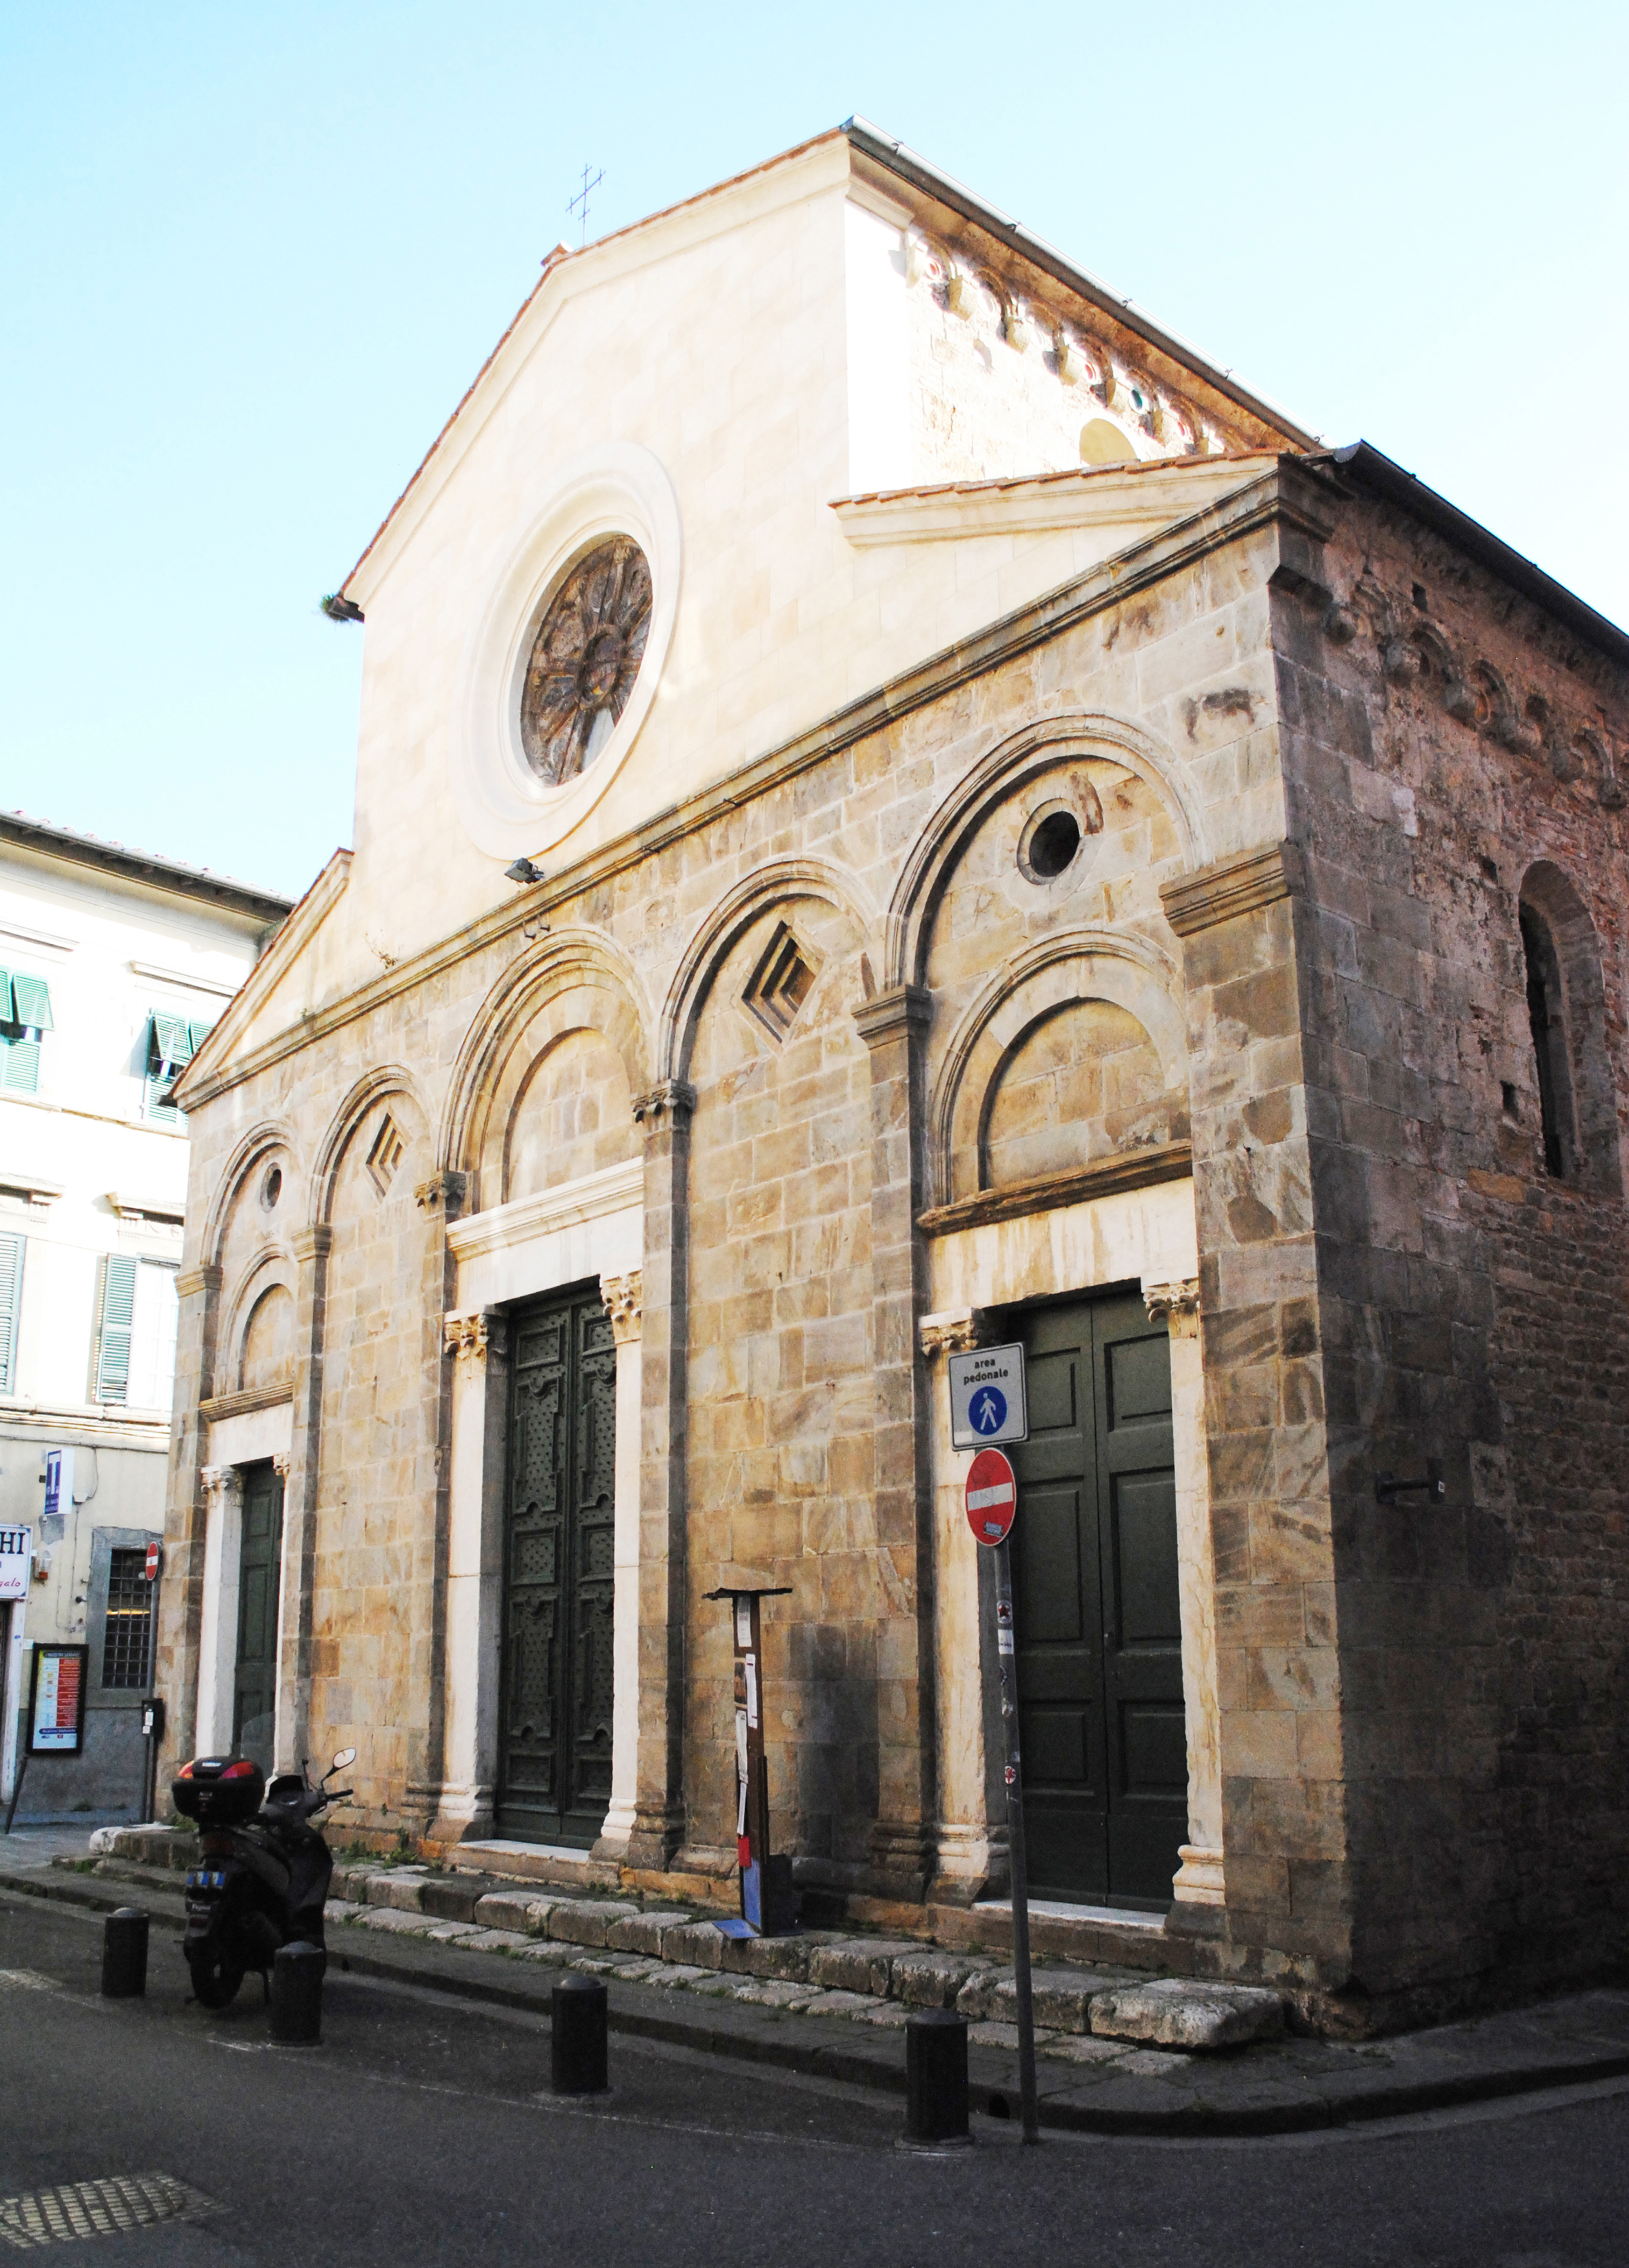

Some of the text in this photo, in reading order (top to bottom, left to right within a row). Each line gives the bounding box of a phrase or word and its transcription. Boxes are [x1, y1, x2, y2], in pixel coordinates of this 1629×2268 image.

[975, 1358, 995, 1369] area
[963, 1368, 1008, 1386] pedonale
[48, 1453, 61, 1494] T
[0, 1531, 26, 1555] HI
